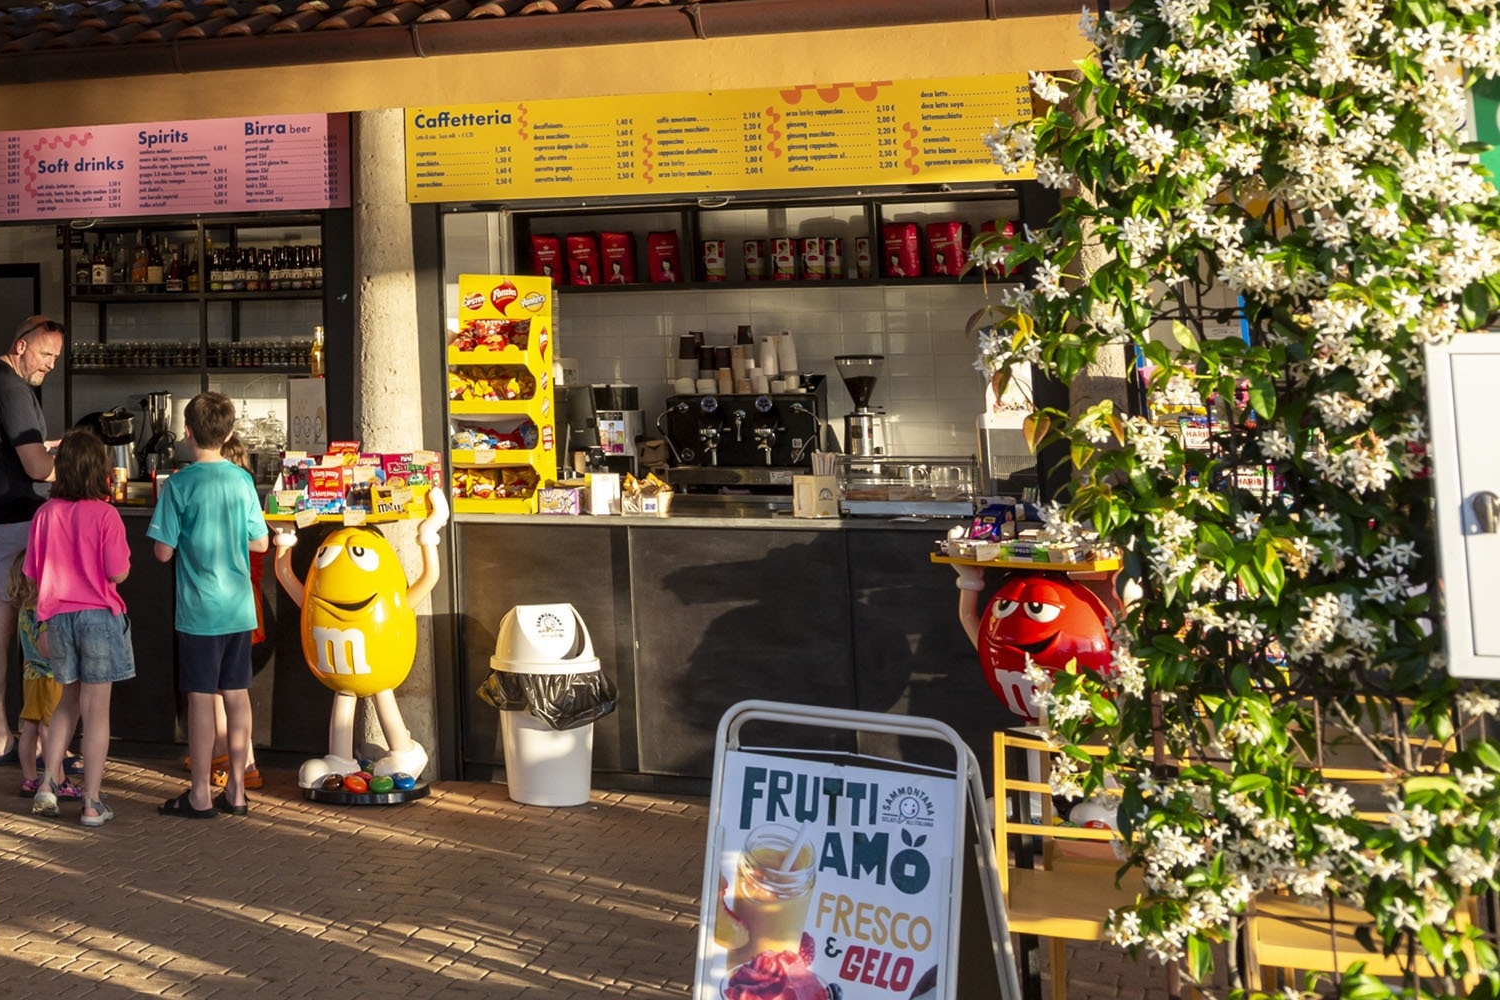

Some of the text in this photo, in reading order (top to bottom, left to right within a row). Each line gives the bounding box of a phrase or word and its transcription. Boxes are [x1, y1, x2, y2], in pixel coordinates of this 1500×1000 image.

[244, 121, 311, 136] Birra beer
[415, 109, 512, 129] Caffetteria
[138, 129, 189, 146] Spirits
[37, 156, 125, 174] Soft drinks
[312, 626, 371, 675] m
[739, 766, 879, 830] FRUTTI
[882, 786, 935, 816] SAMMONTANA
[816, 891, 932, 952] FRESCO
[824, 936, 914, 992] & GELO
